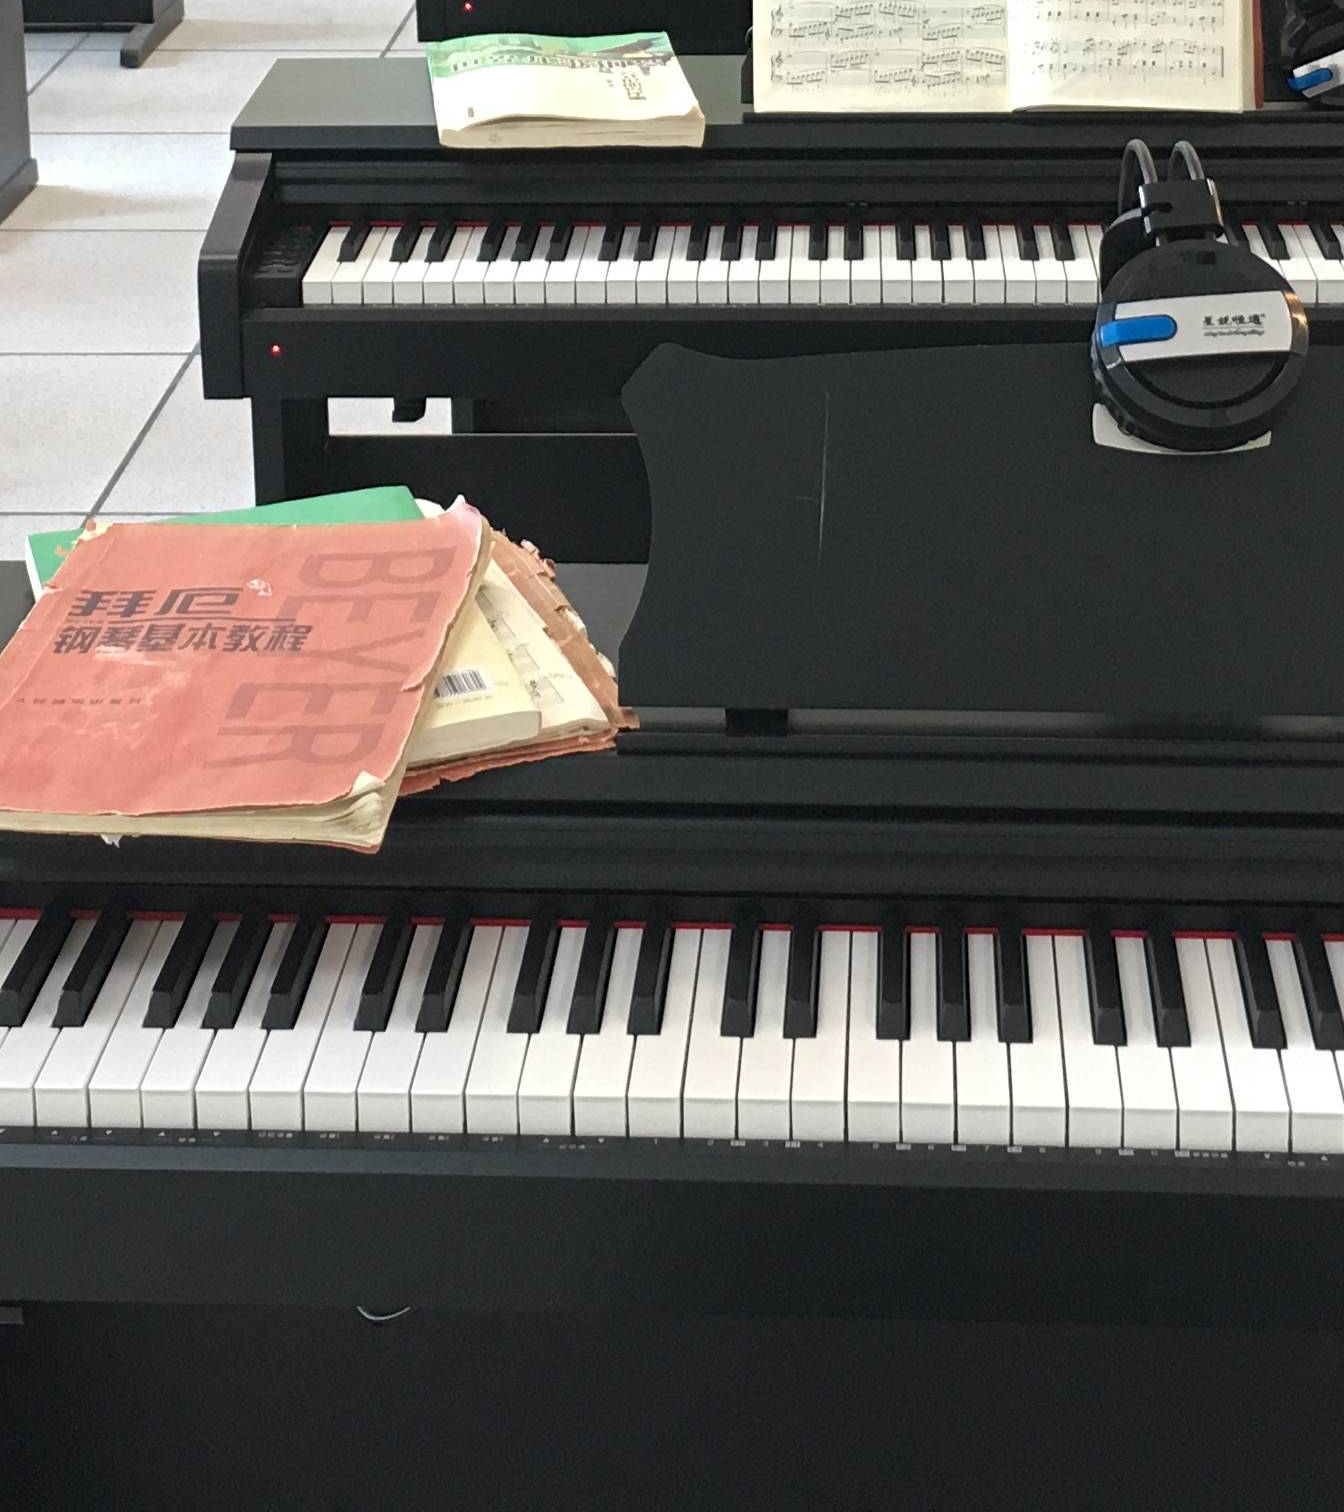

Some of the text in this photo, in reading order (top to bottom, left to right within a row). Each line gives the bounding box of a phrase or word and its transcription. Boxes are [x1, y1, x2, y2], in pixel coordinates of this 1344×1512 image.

[68, 587, 243, 618] 拜厄
[53, 622, 313, 654] 钢琴基本教程
[203, 546, 455, 768] BEYER
